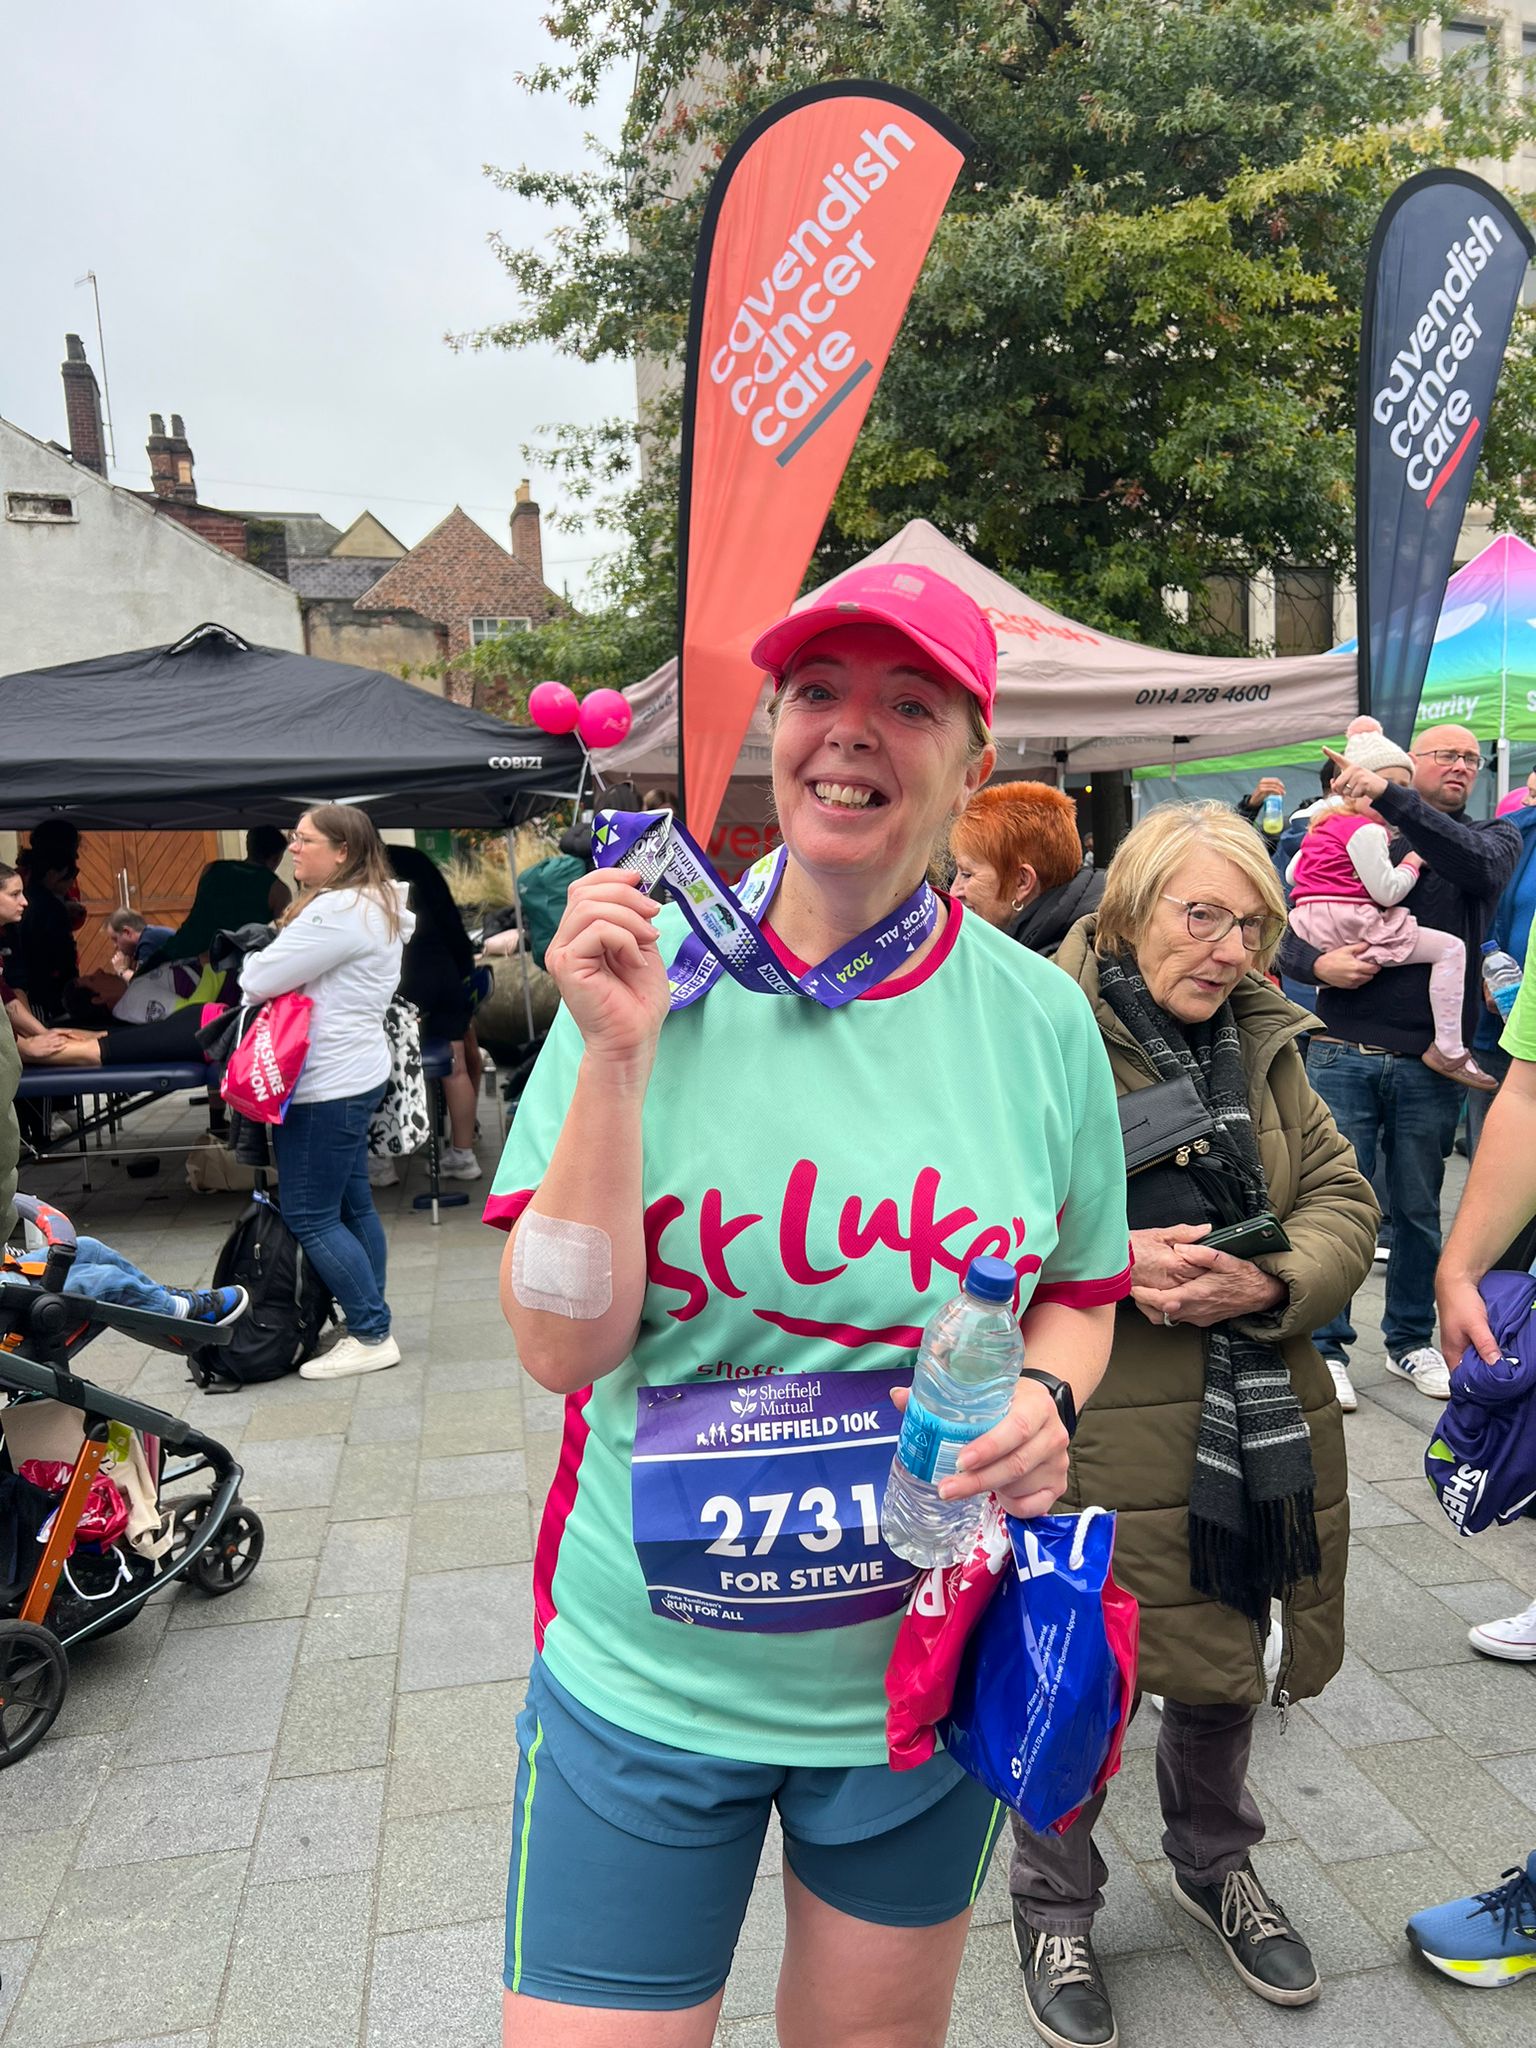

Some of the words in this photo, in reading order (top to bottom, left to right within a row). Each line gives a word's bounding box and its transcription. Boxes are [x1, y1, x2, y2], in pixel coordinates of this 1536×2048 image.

[710, 122, 916, 384] cavendish
[731, 229, 876, 416] cancer
[1373, 215, 1502, 425] cavendish
[751, 330, 856, 446] care
[1390, 302, 1483, 459] cancer
[1406, 389, 1472, 491] care
[1135, 688, 1179, 705] 0114
[1181, 687, 1219, 704] 278
[1222, 684, 1271, 702] 4600
[1415, 694, 1480, 721] harity
[488, 756, 543, 769] COBIZI
[901, 905, 926, 930] FOR
[875, 925, 899, 948] ALL
[835, 951, 874, 983] 2024
[759, 1381, 822, 1400] Sheffield
[760, 1398, 814, 1416] Mutual
[730, 1417, 838, 1443] SHEFFIELD
[840, 1410, 881, 1434] 10K
[1442, 1463, 1482, 1532] SHEF
[700, 1483, 880, 1557] 2731
[720, 1571, 780, 1592] FOR
[790, 1560, 884, 1590] STEVIE
[666, 1600, 692, 1612] RUN
[695, 1605, 718, 1618] FOR
[721, 1610, 744, 1621] ALL
[1066, 1608, 1076, 1633] Appeal
[1058, 1632, 1071, 1664] Tomlinson
[1054, 1665, 1063, 1683] Jane
